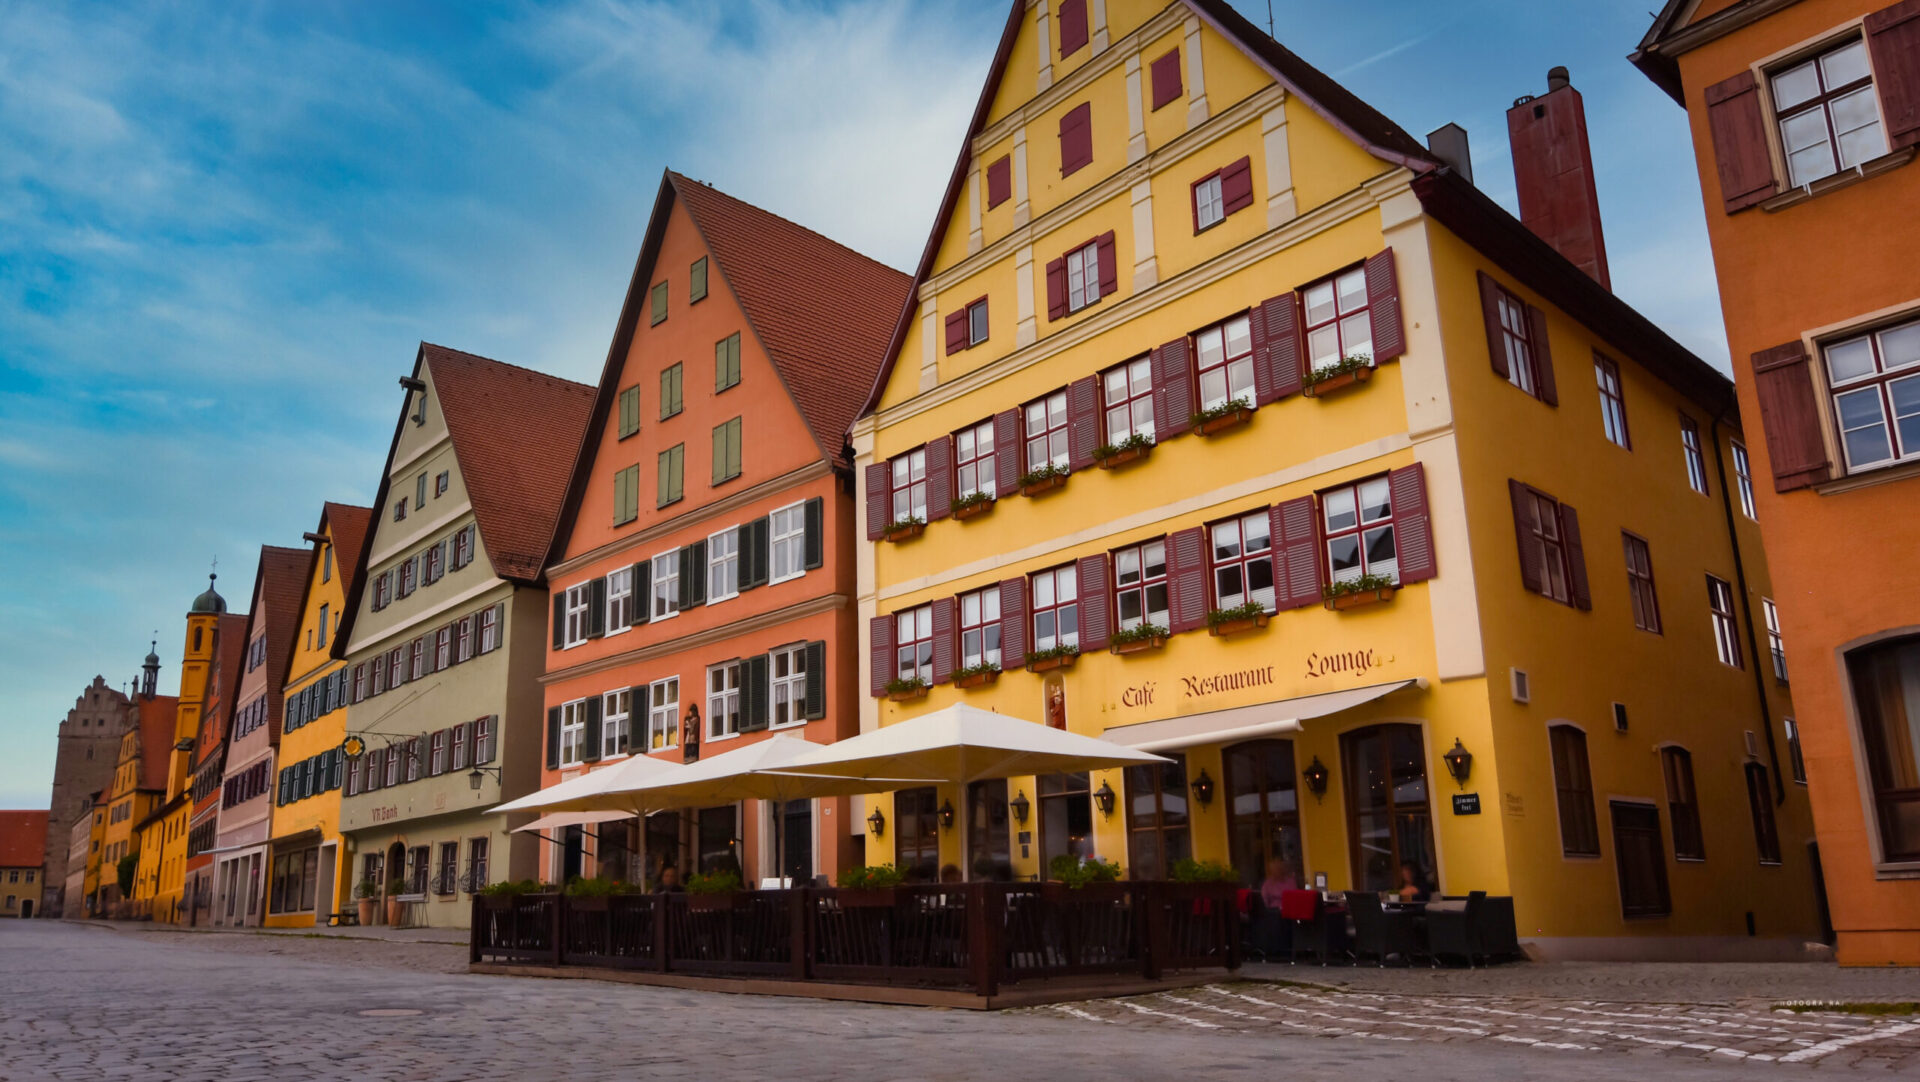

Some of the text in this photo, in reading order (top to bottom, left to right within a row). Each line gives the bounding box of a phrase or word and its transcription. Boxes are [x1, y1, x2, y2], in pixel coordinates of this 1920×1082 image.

[1122, 648, 1374, 711] Café Restaurant Lounge
[371, 807, 381, 822] VR
